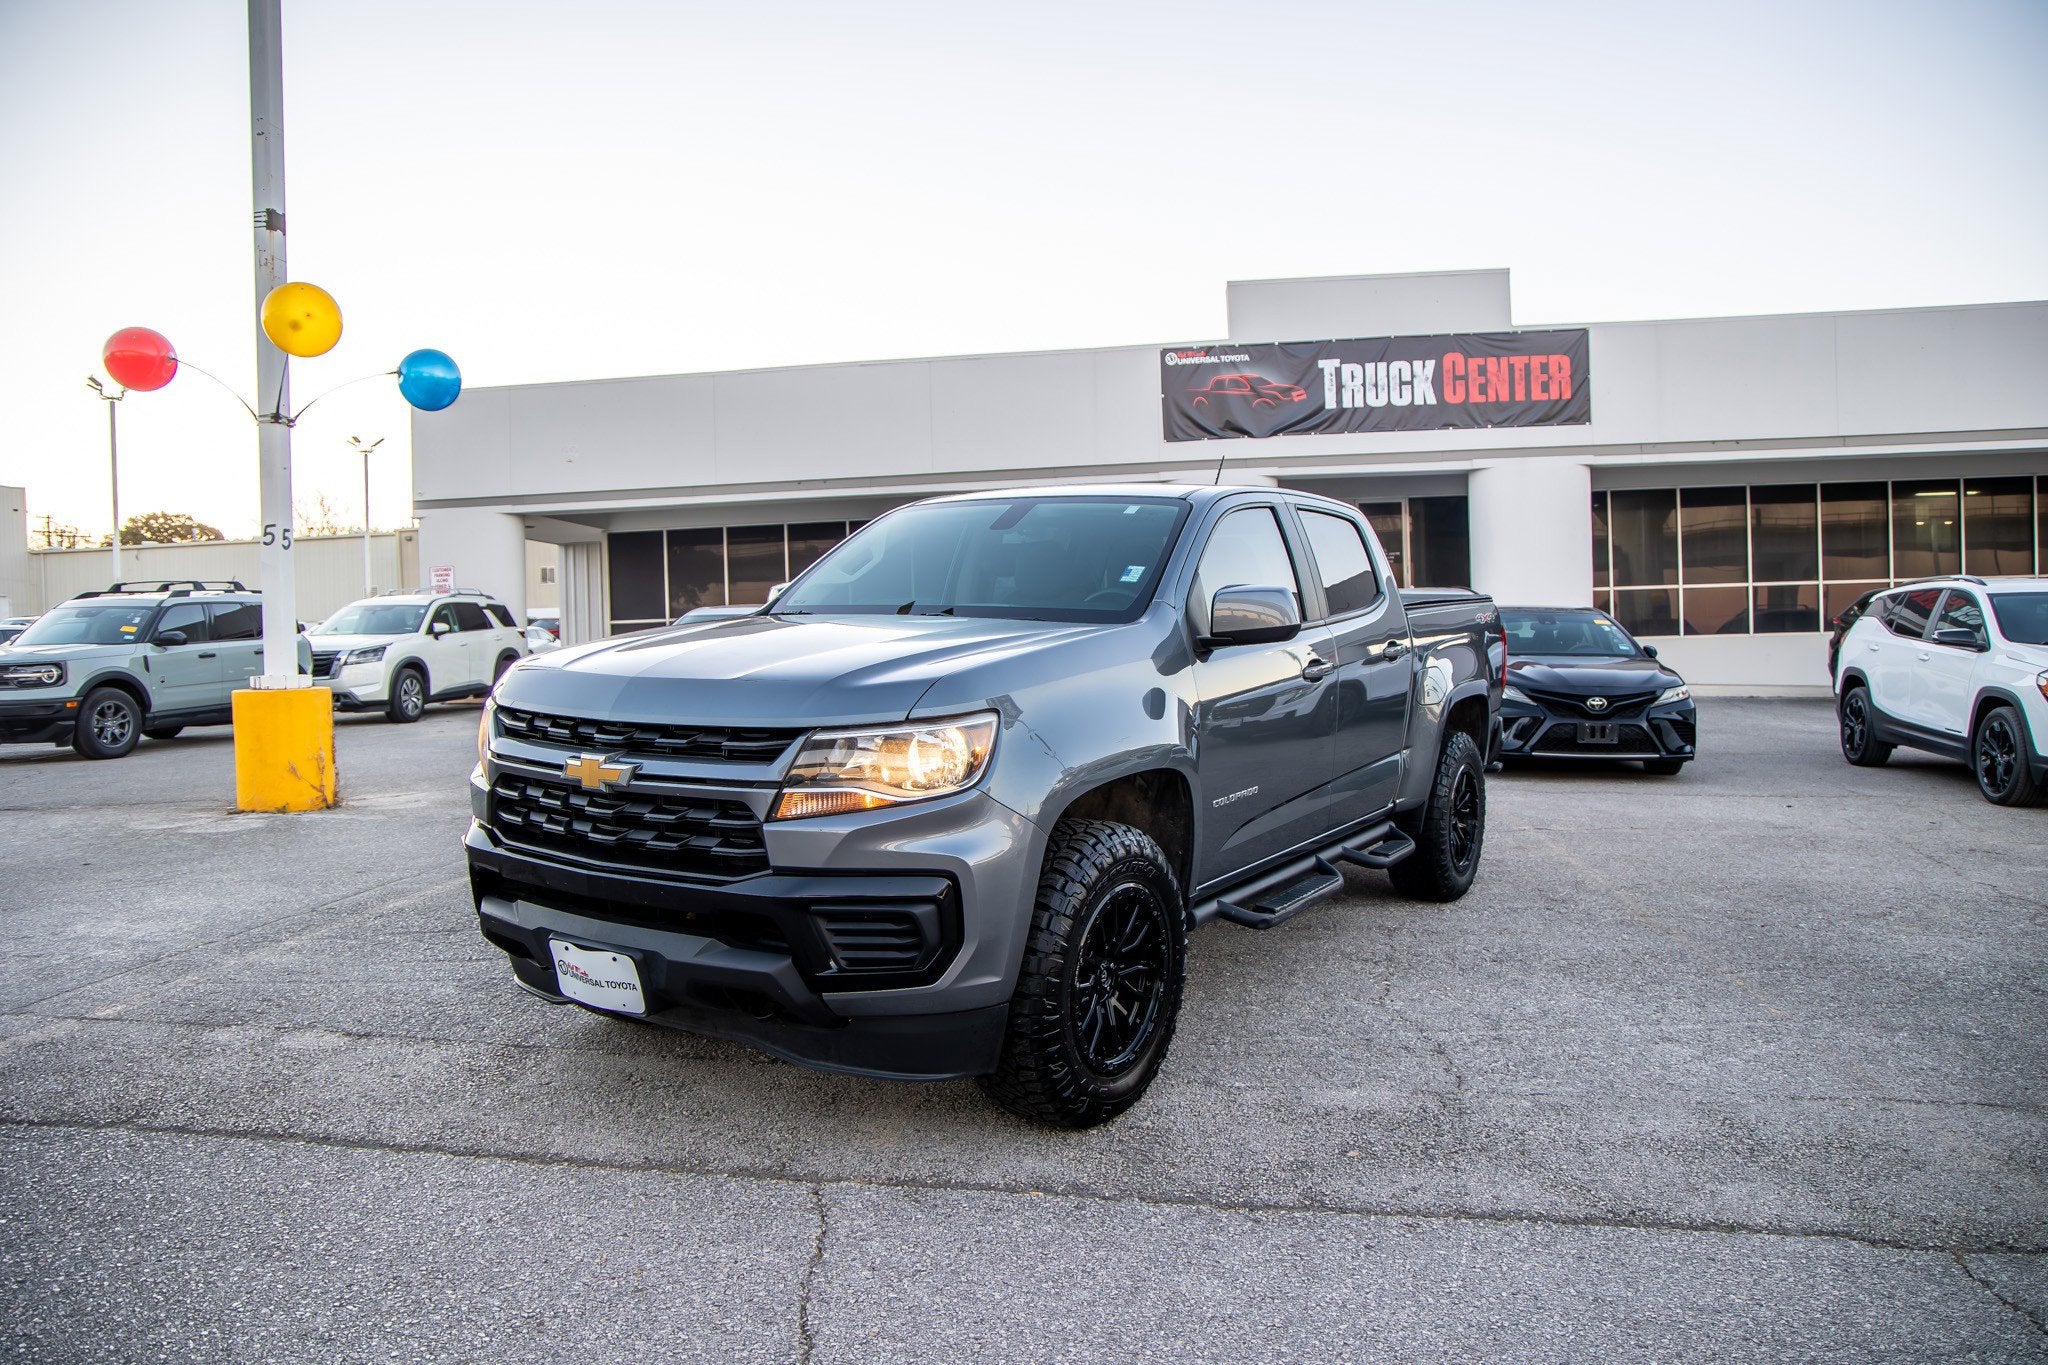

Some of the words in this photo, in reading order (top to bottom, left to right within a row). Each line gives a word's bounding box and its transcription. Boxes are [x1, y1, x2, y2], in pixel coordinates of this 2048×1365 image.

[1177, 355, 1220, 365] UNIVERSAL
[1220, 354, 1250, 363] TOYOTA
[1317, 358, 1438, 410] TRUCK
[1442, 351, 1573, 405] CENTER
[1212, 785, 1259, 808] COLORADO
[568, 969, 604, 988] UNIVERSAL
[605, 980, 638, 991] TOYOTA
